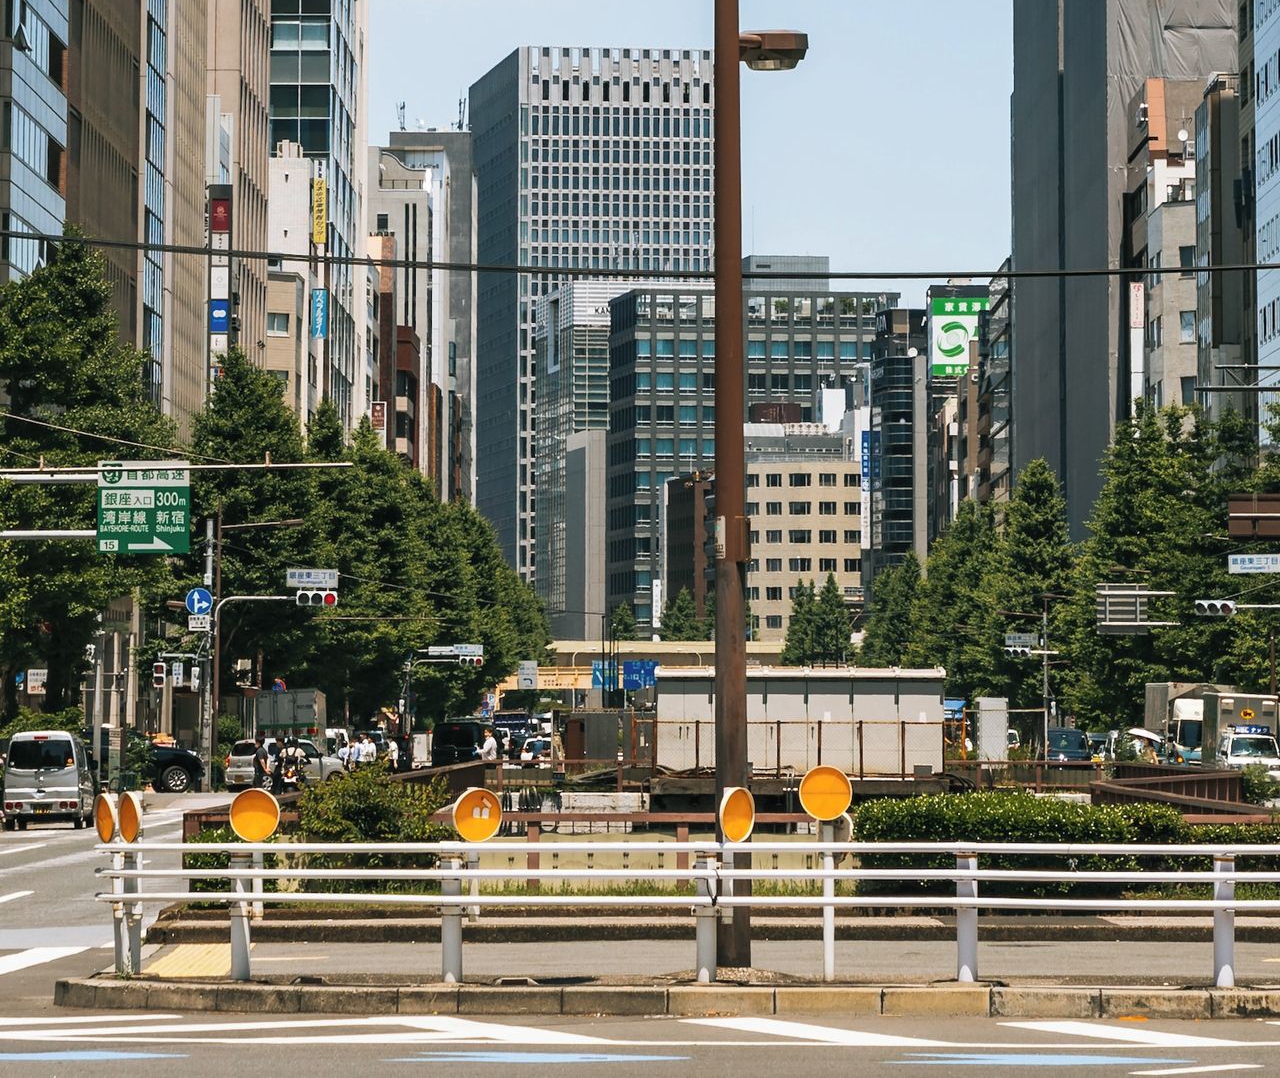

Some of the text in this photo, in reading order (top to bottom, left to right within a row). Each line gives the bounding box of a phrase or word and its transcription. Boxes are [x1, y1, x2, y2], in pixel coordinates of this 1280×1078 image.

[156, 492, 186, 506] 300m
[102, 510, 185, 524] 湾岸線 新宿
[155, 525, 185, 534] Shinjuku
[103, 541, 115, 550] 15
